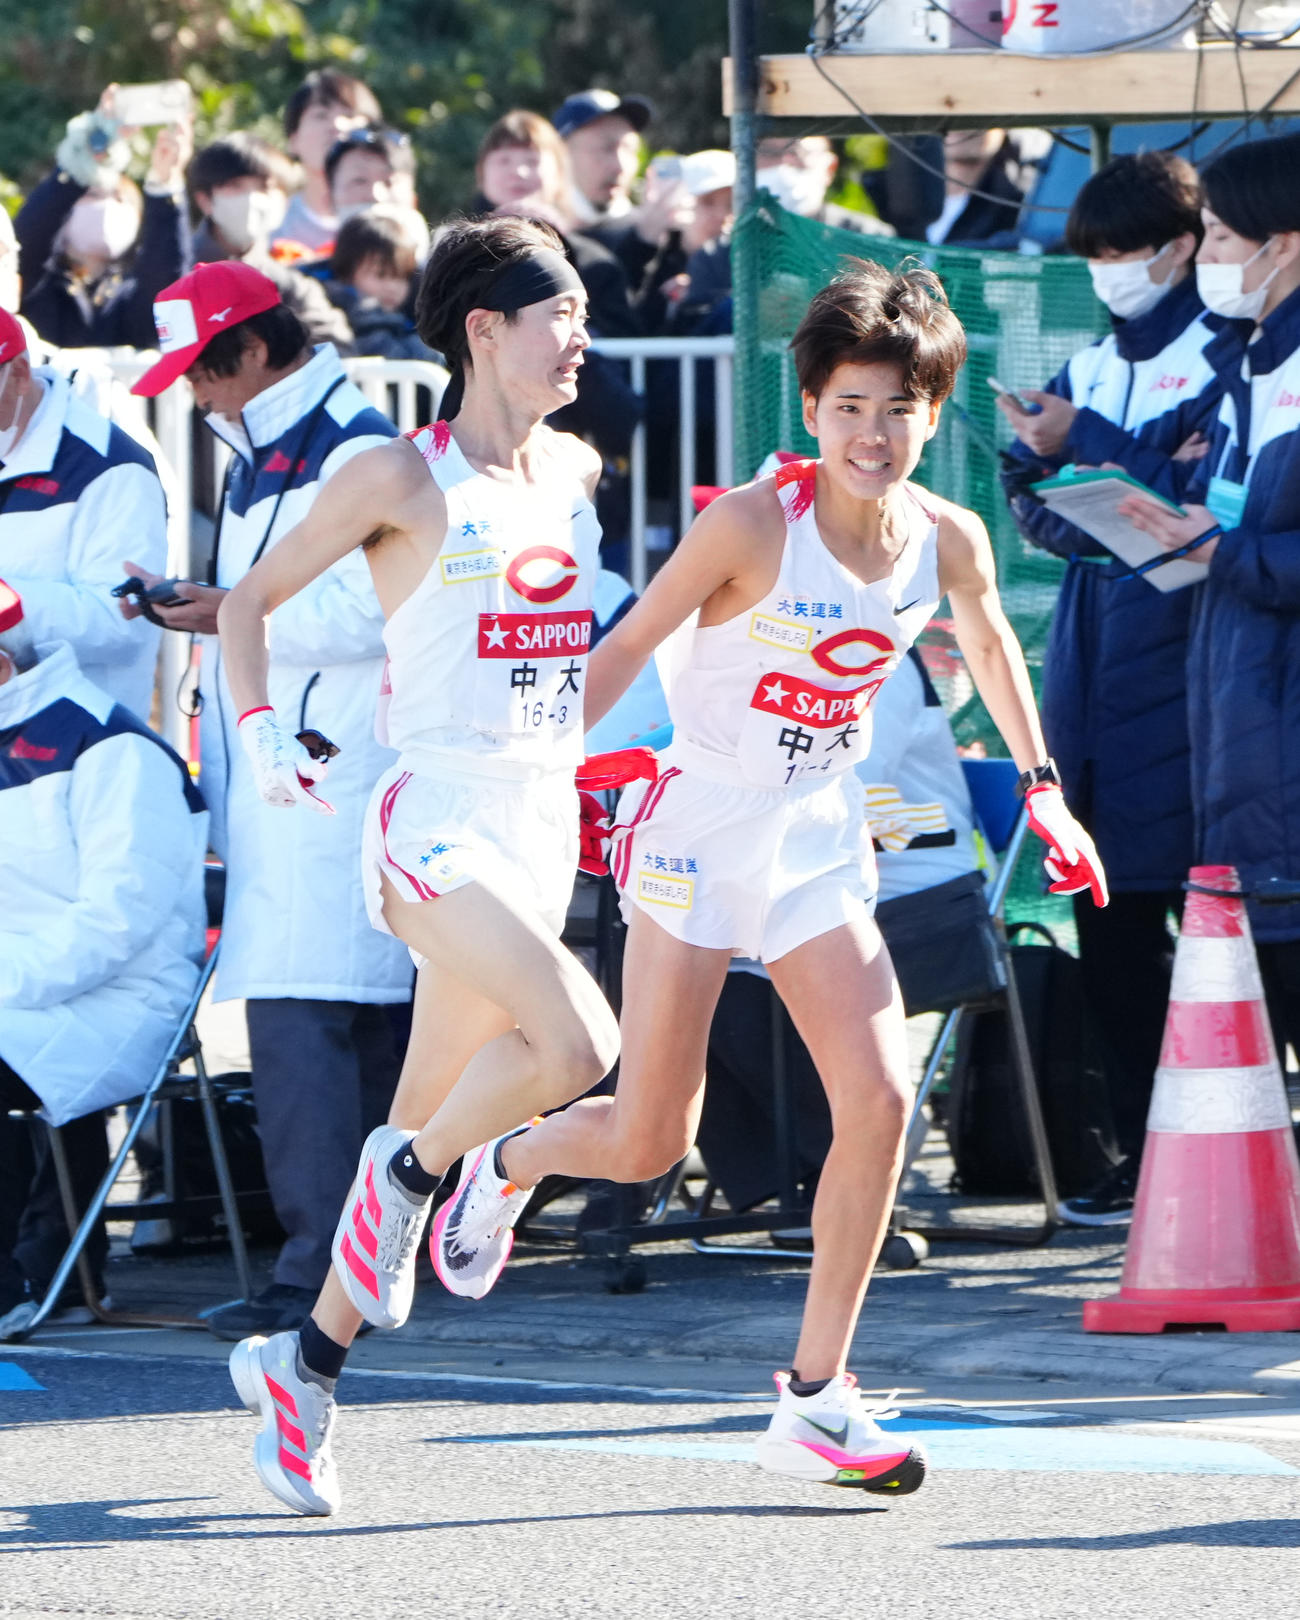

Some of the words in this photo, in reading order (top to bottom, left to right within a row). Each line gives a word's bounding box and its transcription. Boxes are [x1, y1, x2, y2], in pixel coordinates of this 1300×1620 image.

[777, 600, 842, 618] 大矢運送
[514, 621, 591, 650] SAPPOR
[510, 659, 581, 698] 中大
[522, 701, 567, 728] 16-3
[778, 723, 860, 760] 中大
[643, 852, 698, 873] 大矢運送
